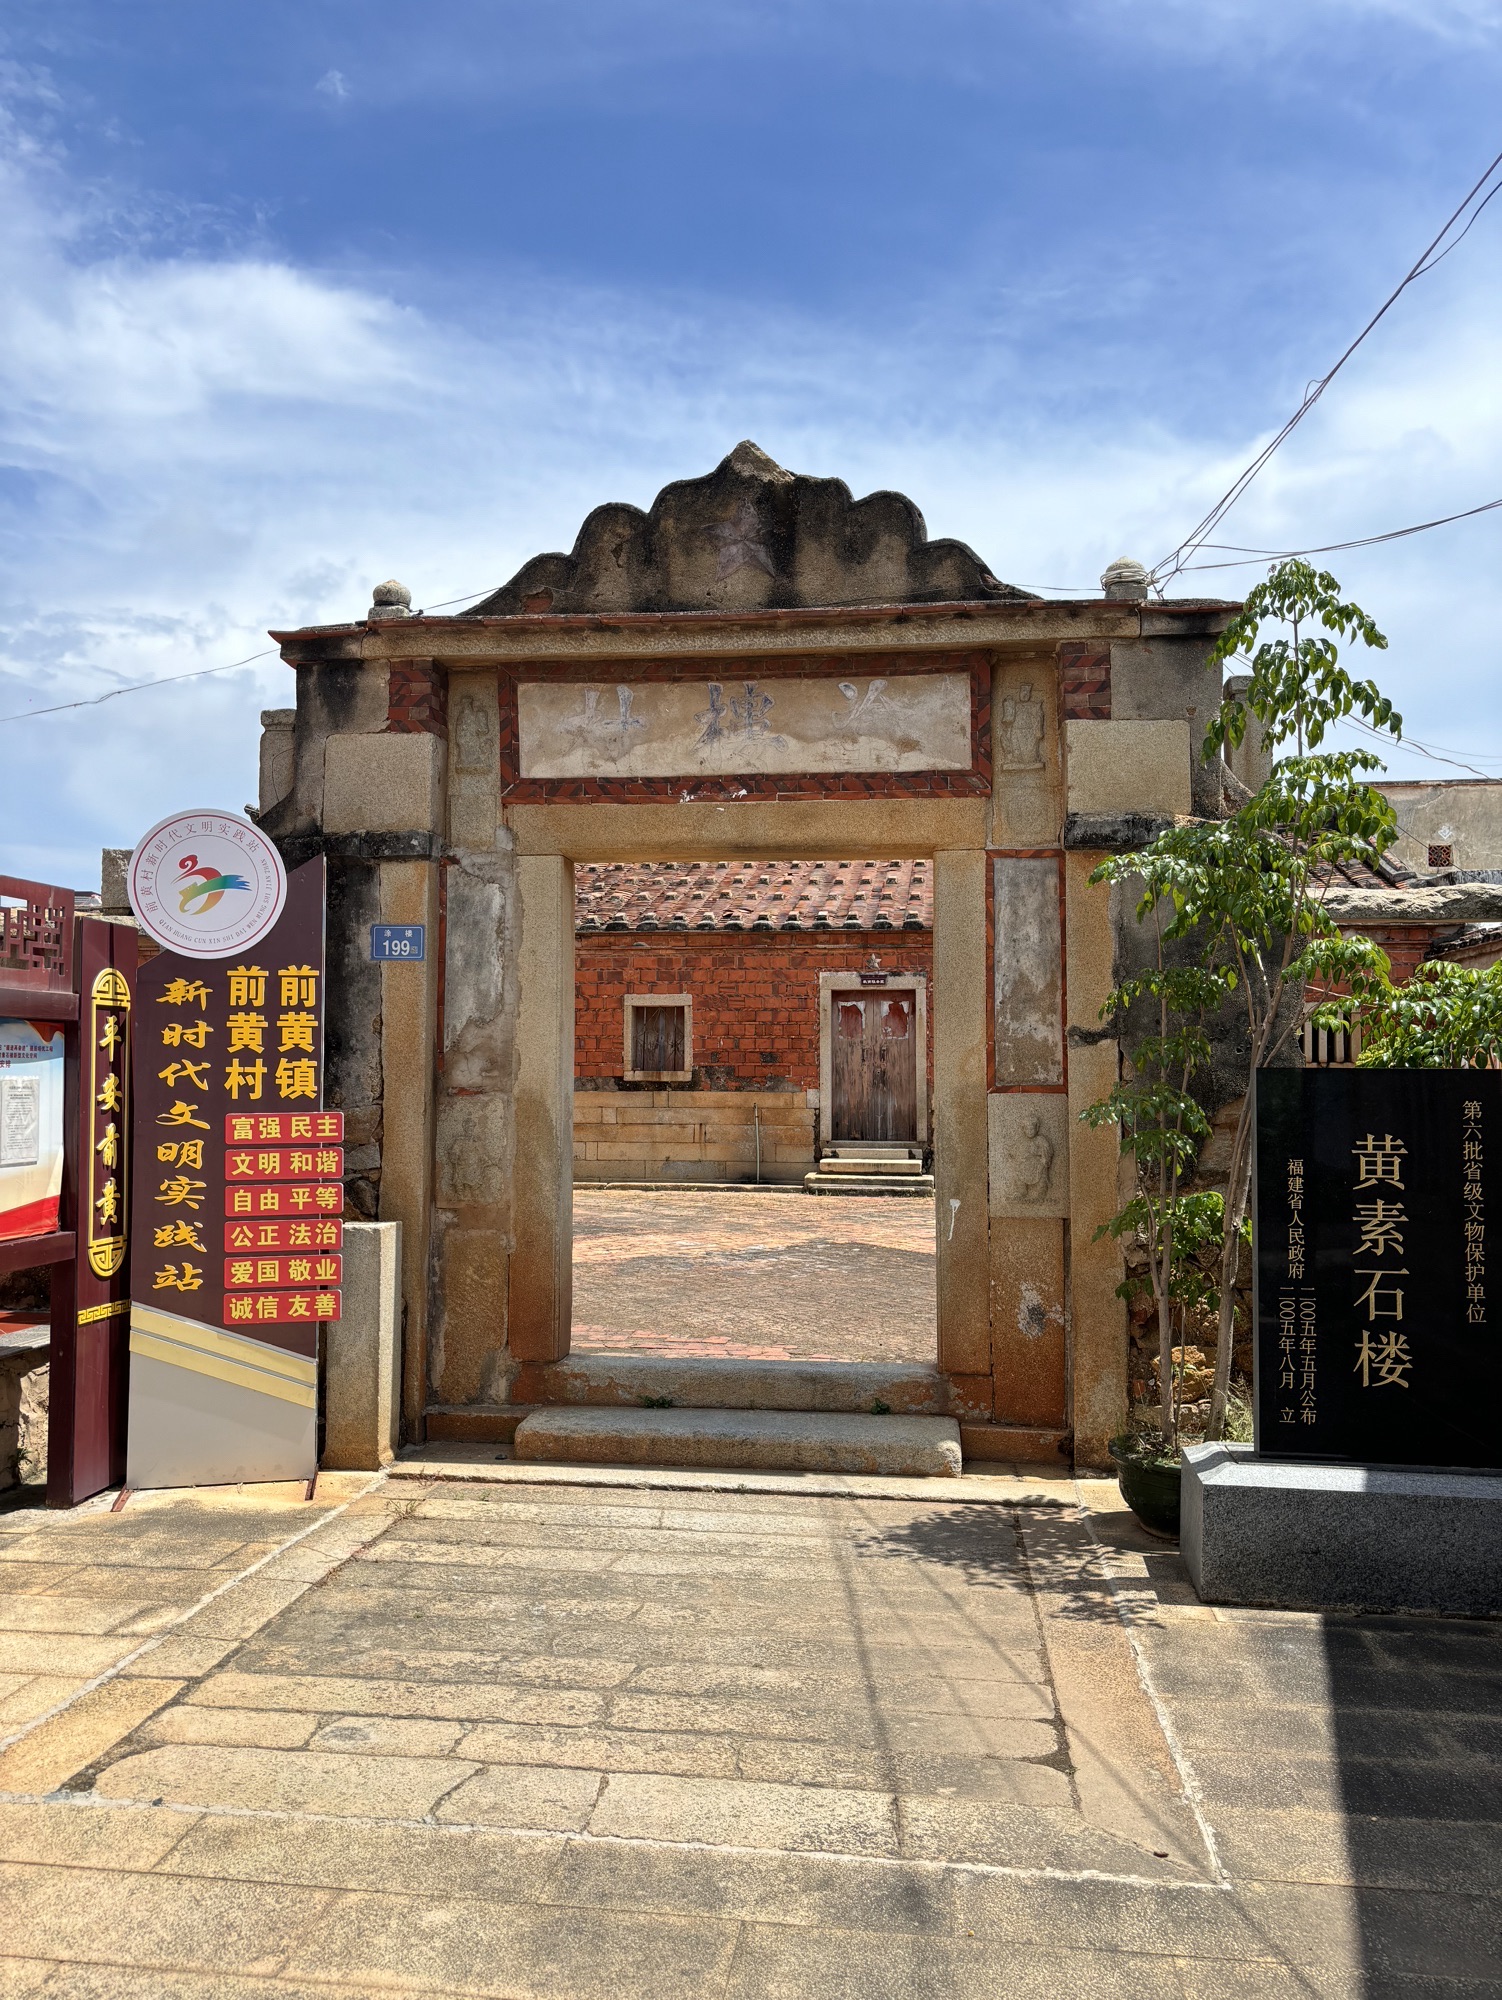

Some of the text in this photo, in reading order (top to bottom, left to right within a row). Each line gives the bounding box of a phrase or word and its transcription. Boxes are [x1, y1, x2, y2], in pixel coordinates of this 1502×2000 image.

[140, 820, 260, 913] 前黄村新时代文明实践站
[260, 858, 271, 874] ZHAN
[263, 893, 271, 904] SHI
[246, 920, 258, 929] WEN
[256, 905, 268, 919] MING
[159, 919, 173, 932] QIAN
[173, 930, 193, 942] HUANG
[235, 927, 247, 938] DAI
[223, 934, 234, 943] SHI
[382, 940, 410, 956] 199
[223, 965, 269, 1100] 前黄村
[275, 965, 320, 1100] 前黄镇
[96, 1016, 122, 1225] 平安前黄
[231, 1115, 339, 1140] 富强 民主
[152, 977, 214, 1291] 新时代文明实践站
[231, 1151, 339, 1175] 文明 和谐
[233, 1186, 339, 1212] 自由 平等
[1286, 1158, 1305, 1280] 福建省人民政府
[1462, 1100, 1487, 1324] 第六批省级文物保护单位
[230, 1222, 338, 1247] 公正 法治
[230, 1258, 338, 1285] 爱国 敬业
[1351, 1133, 1413, 1389] 黄素石楼
[229, 1293, 337, 1320] 诚信 友善
